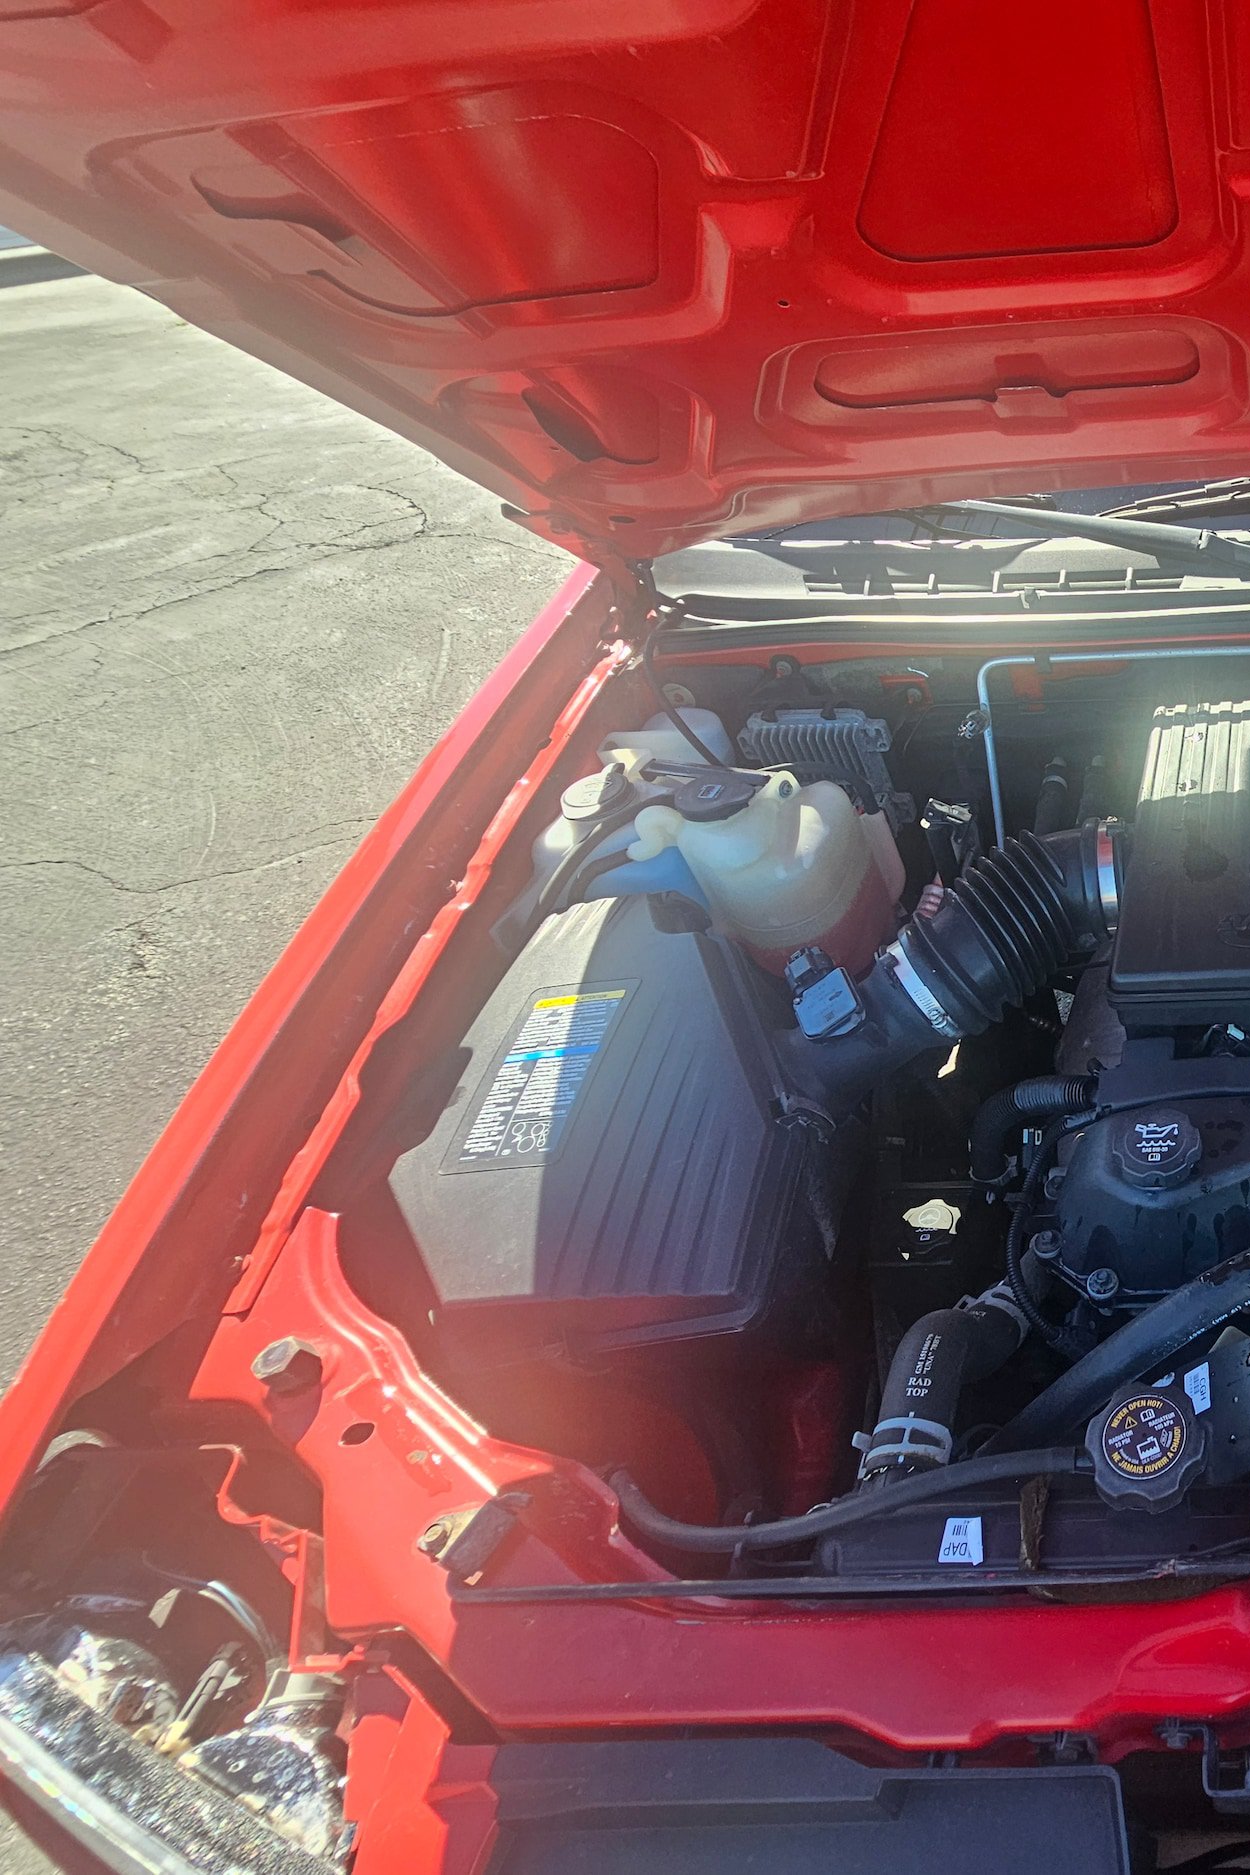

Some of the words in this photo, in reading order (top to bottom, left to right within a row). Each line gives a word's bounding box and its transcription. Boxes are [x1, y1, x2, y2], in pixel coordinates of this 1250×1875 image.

[908, 1377, 932, 1387] RAD
[906, 1387, 928, 1397] TOP
[1111, 1408, 1128, 1428] NEVER
[1128, 1400, 1146, 1411] OPEN
[1147, 1400, 1164, 1410] HOT!
[1148, 1412, 1175, 1427] RADIATEUR
[1108, 1430, 1133, 1445] RADIATOR
[1111, 1451, 1122, 1463] NE
[1118, 1459, 1144, 1474] JAMAIS
[1144, 1456, 1170, 1474] OUVRIR
[1170, 1425, 1181, 1452] CHAUD!
[943, 1542, 968, 1557] DAP
